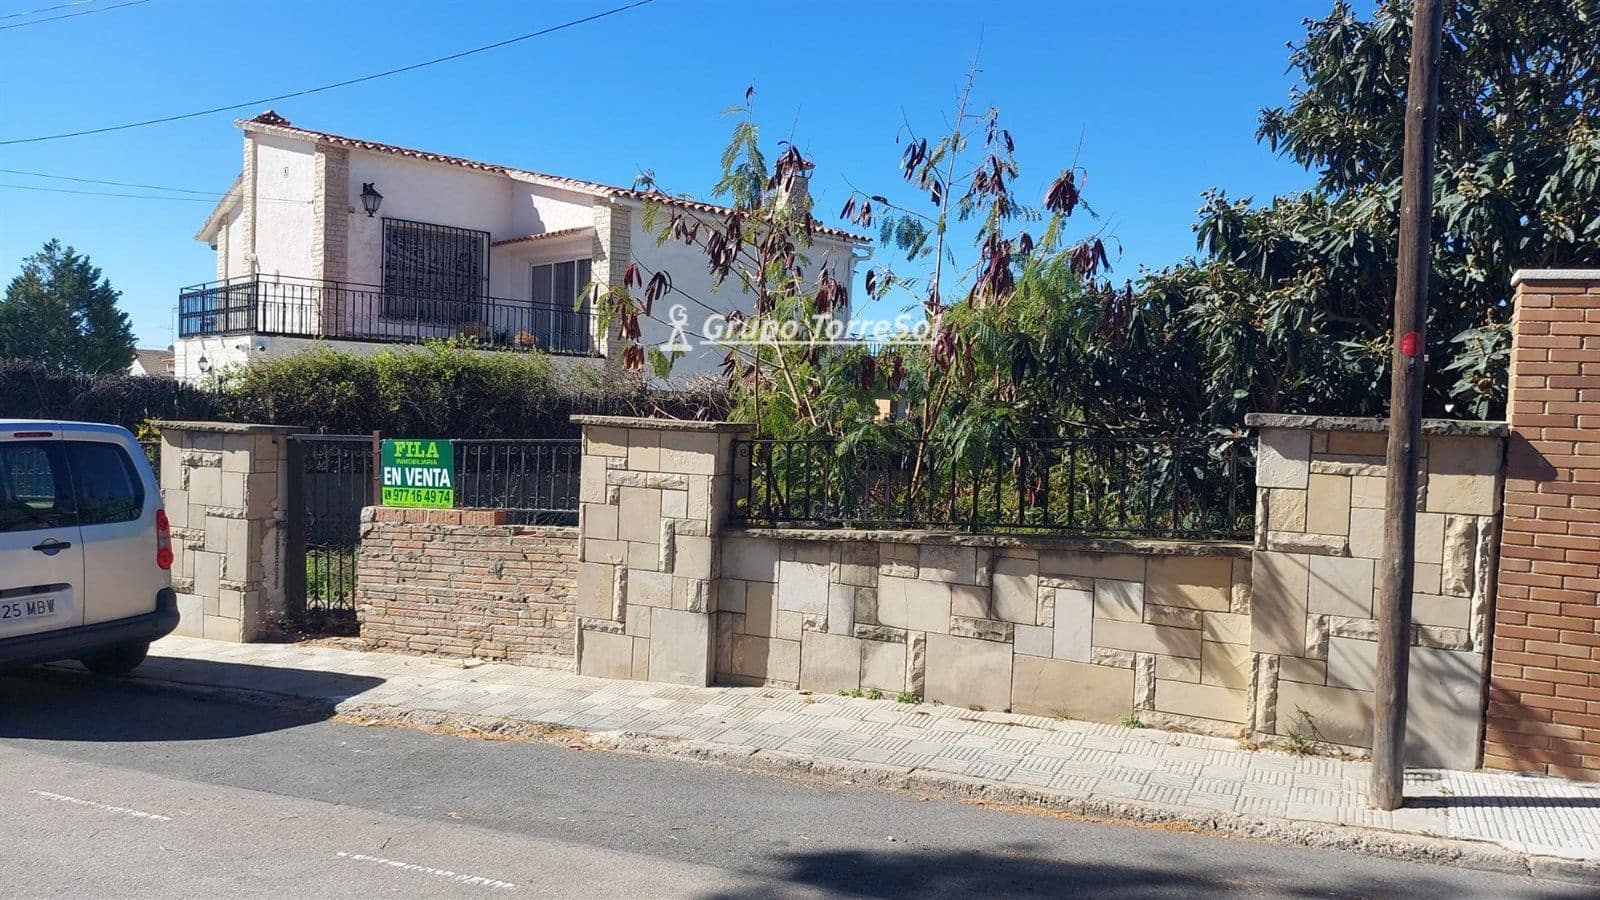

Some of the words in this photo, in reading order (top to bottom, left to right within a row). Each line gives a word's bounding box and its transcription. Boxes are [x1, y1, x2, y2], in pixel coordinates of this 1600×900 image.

[394, 441, 439, 458] FILA
[384, 466, 402, 486] EN
[405, 467, 451, 488] VENTA
[393, 488, 410, 502] 977
[411, 490, 422, 503] 16
[424, 490, 436, 503] 49
[438, 490, 450, 504] 74
[26, 599, 55, 616] MBW
